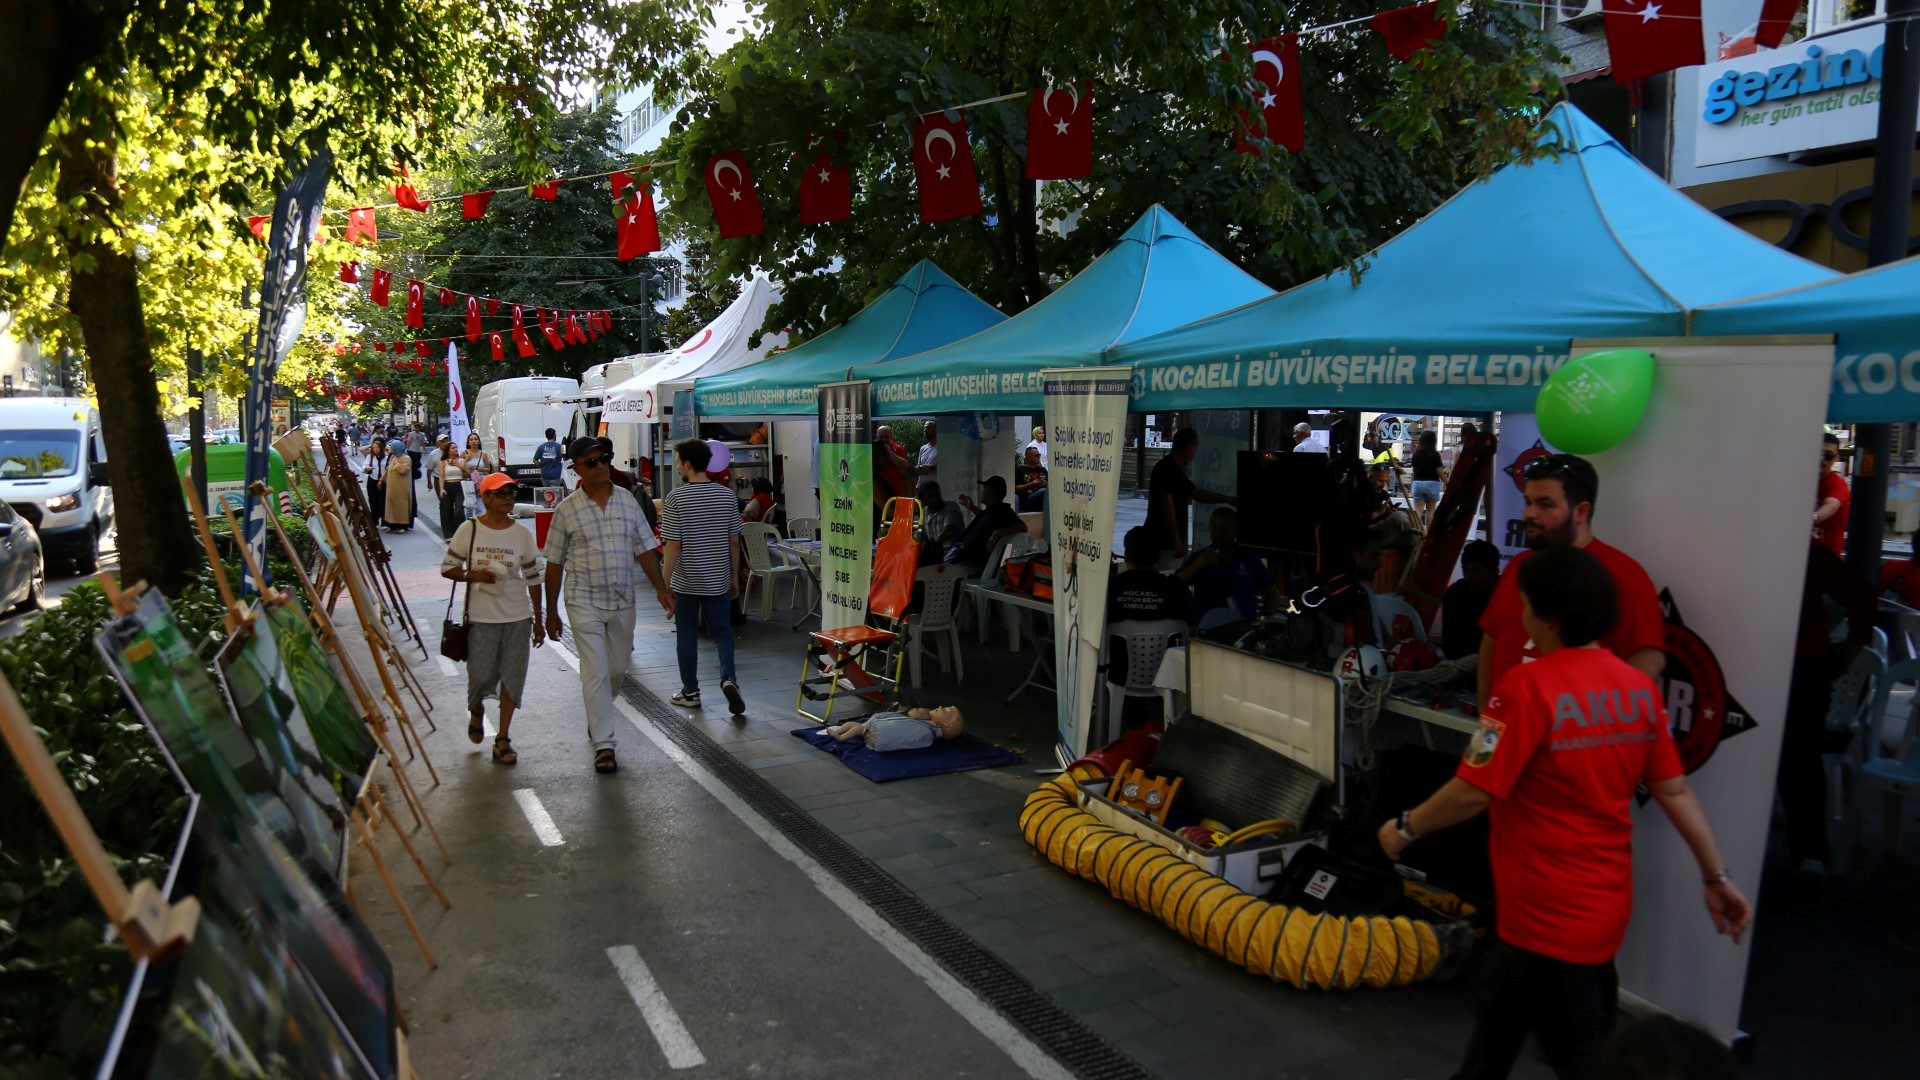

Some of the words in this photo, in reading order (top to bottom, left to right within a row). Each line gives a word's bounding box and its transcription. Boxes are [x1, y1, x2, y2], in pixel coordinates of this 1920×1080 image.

[1740, 108, 1768, 126] her
[1770, 102, 1803, 126] gün
[1807, 92, 1843, 115] tatil
[876, 377, 919, 403] KOCAELİ
[922, 368, 998, 401] BÜYÜKŞEHİR
[1152, 355, 1240, 391] KOCAELİ
[1247, 346, 1416, 392] BÜYÜKŞEHİR
[709, 387, 736, 407] KOCAELİ
[739, 385, 785, 408] BÜYÜKŞEHİR
[1381, 422, 1411, 440] SGK
[1063, 510, 1081, 531] ağlık
[1550, 689, 1657, 732] AKUT
